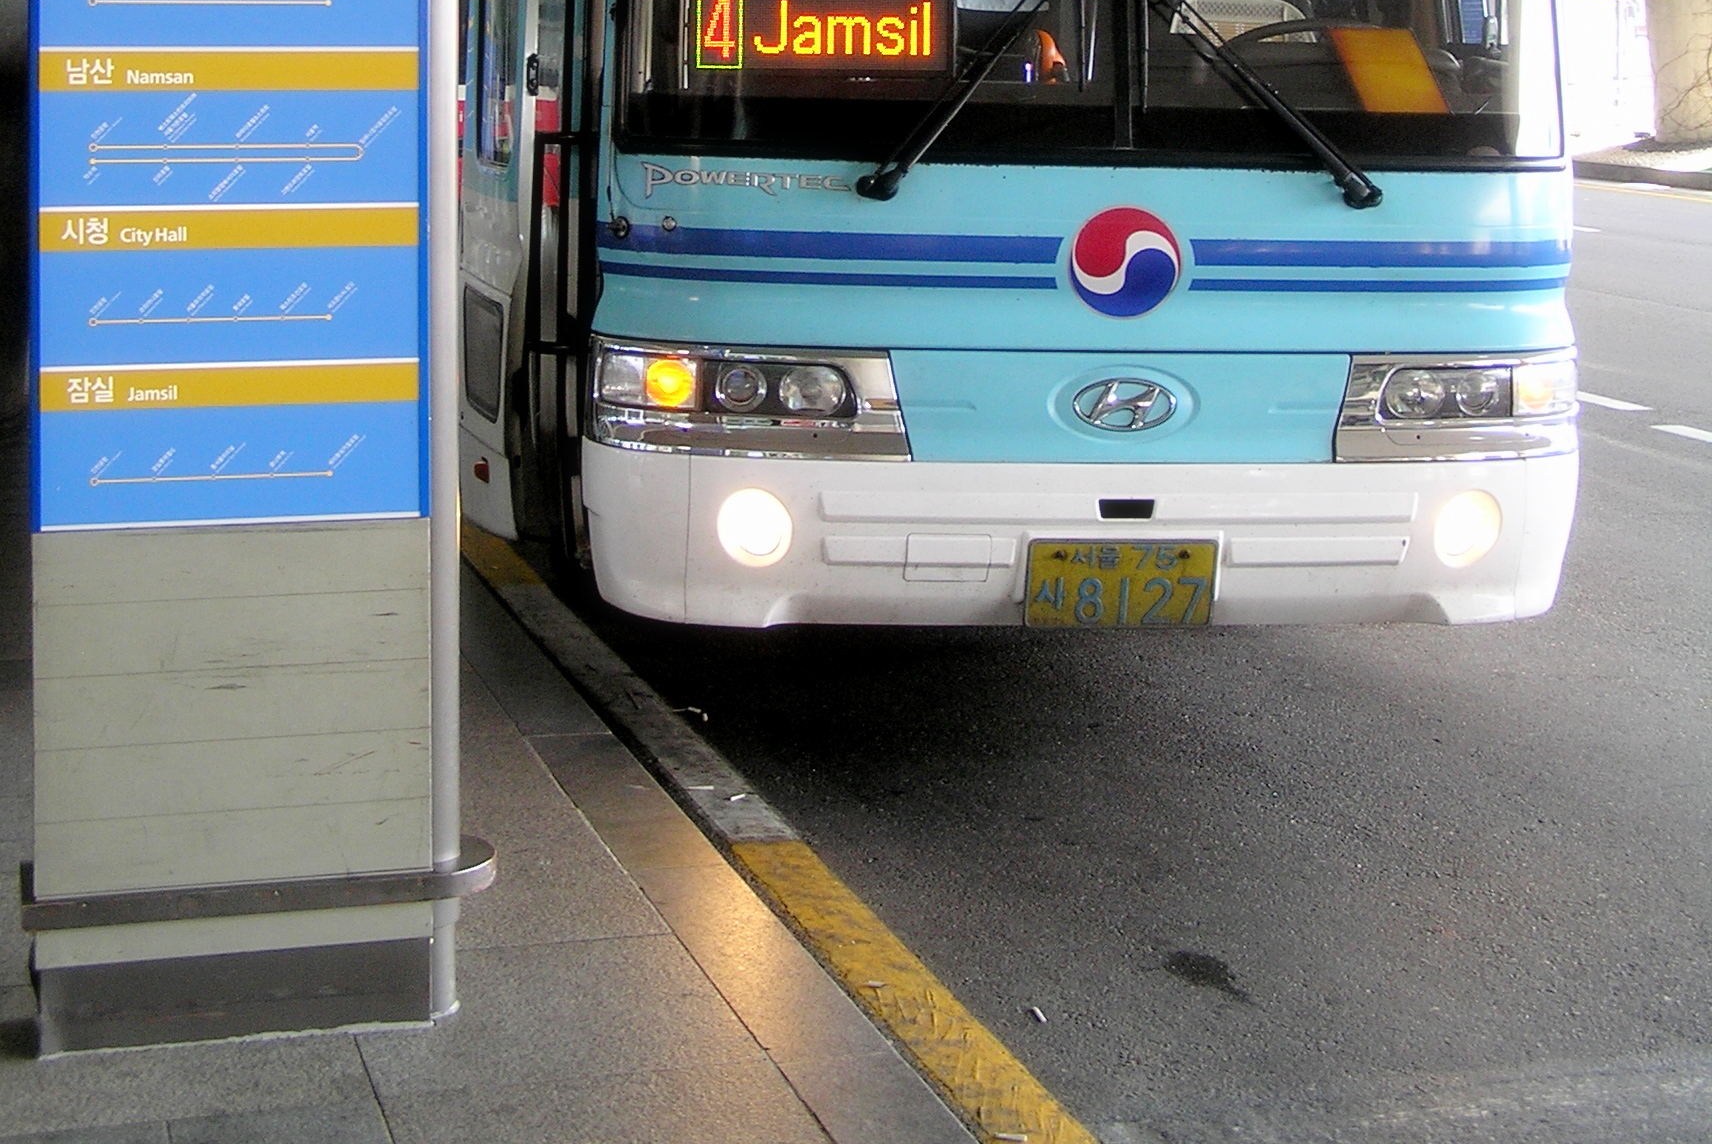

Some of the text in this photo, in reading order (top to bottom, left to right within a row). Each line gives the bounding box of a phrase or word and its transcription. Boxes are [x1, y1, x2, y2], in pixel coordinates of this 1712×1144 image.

[754, 0, 931, 56] Jamsil
[67, 59, 114, 84] 남산
[127, 70, 193, 84] Namsan
[62, 218, 107, 244] 시청
[120, 227, 186, 246] City Hall
[67, 377, 113, 403] 잠실
[128, 386, 177, 401] Jamsil
[1071, 546, 1178, 571] 서울 75
